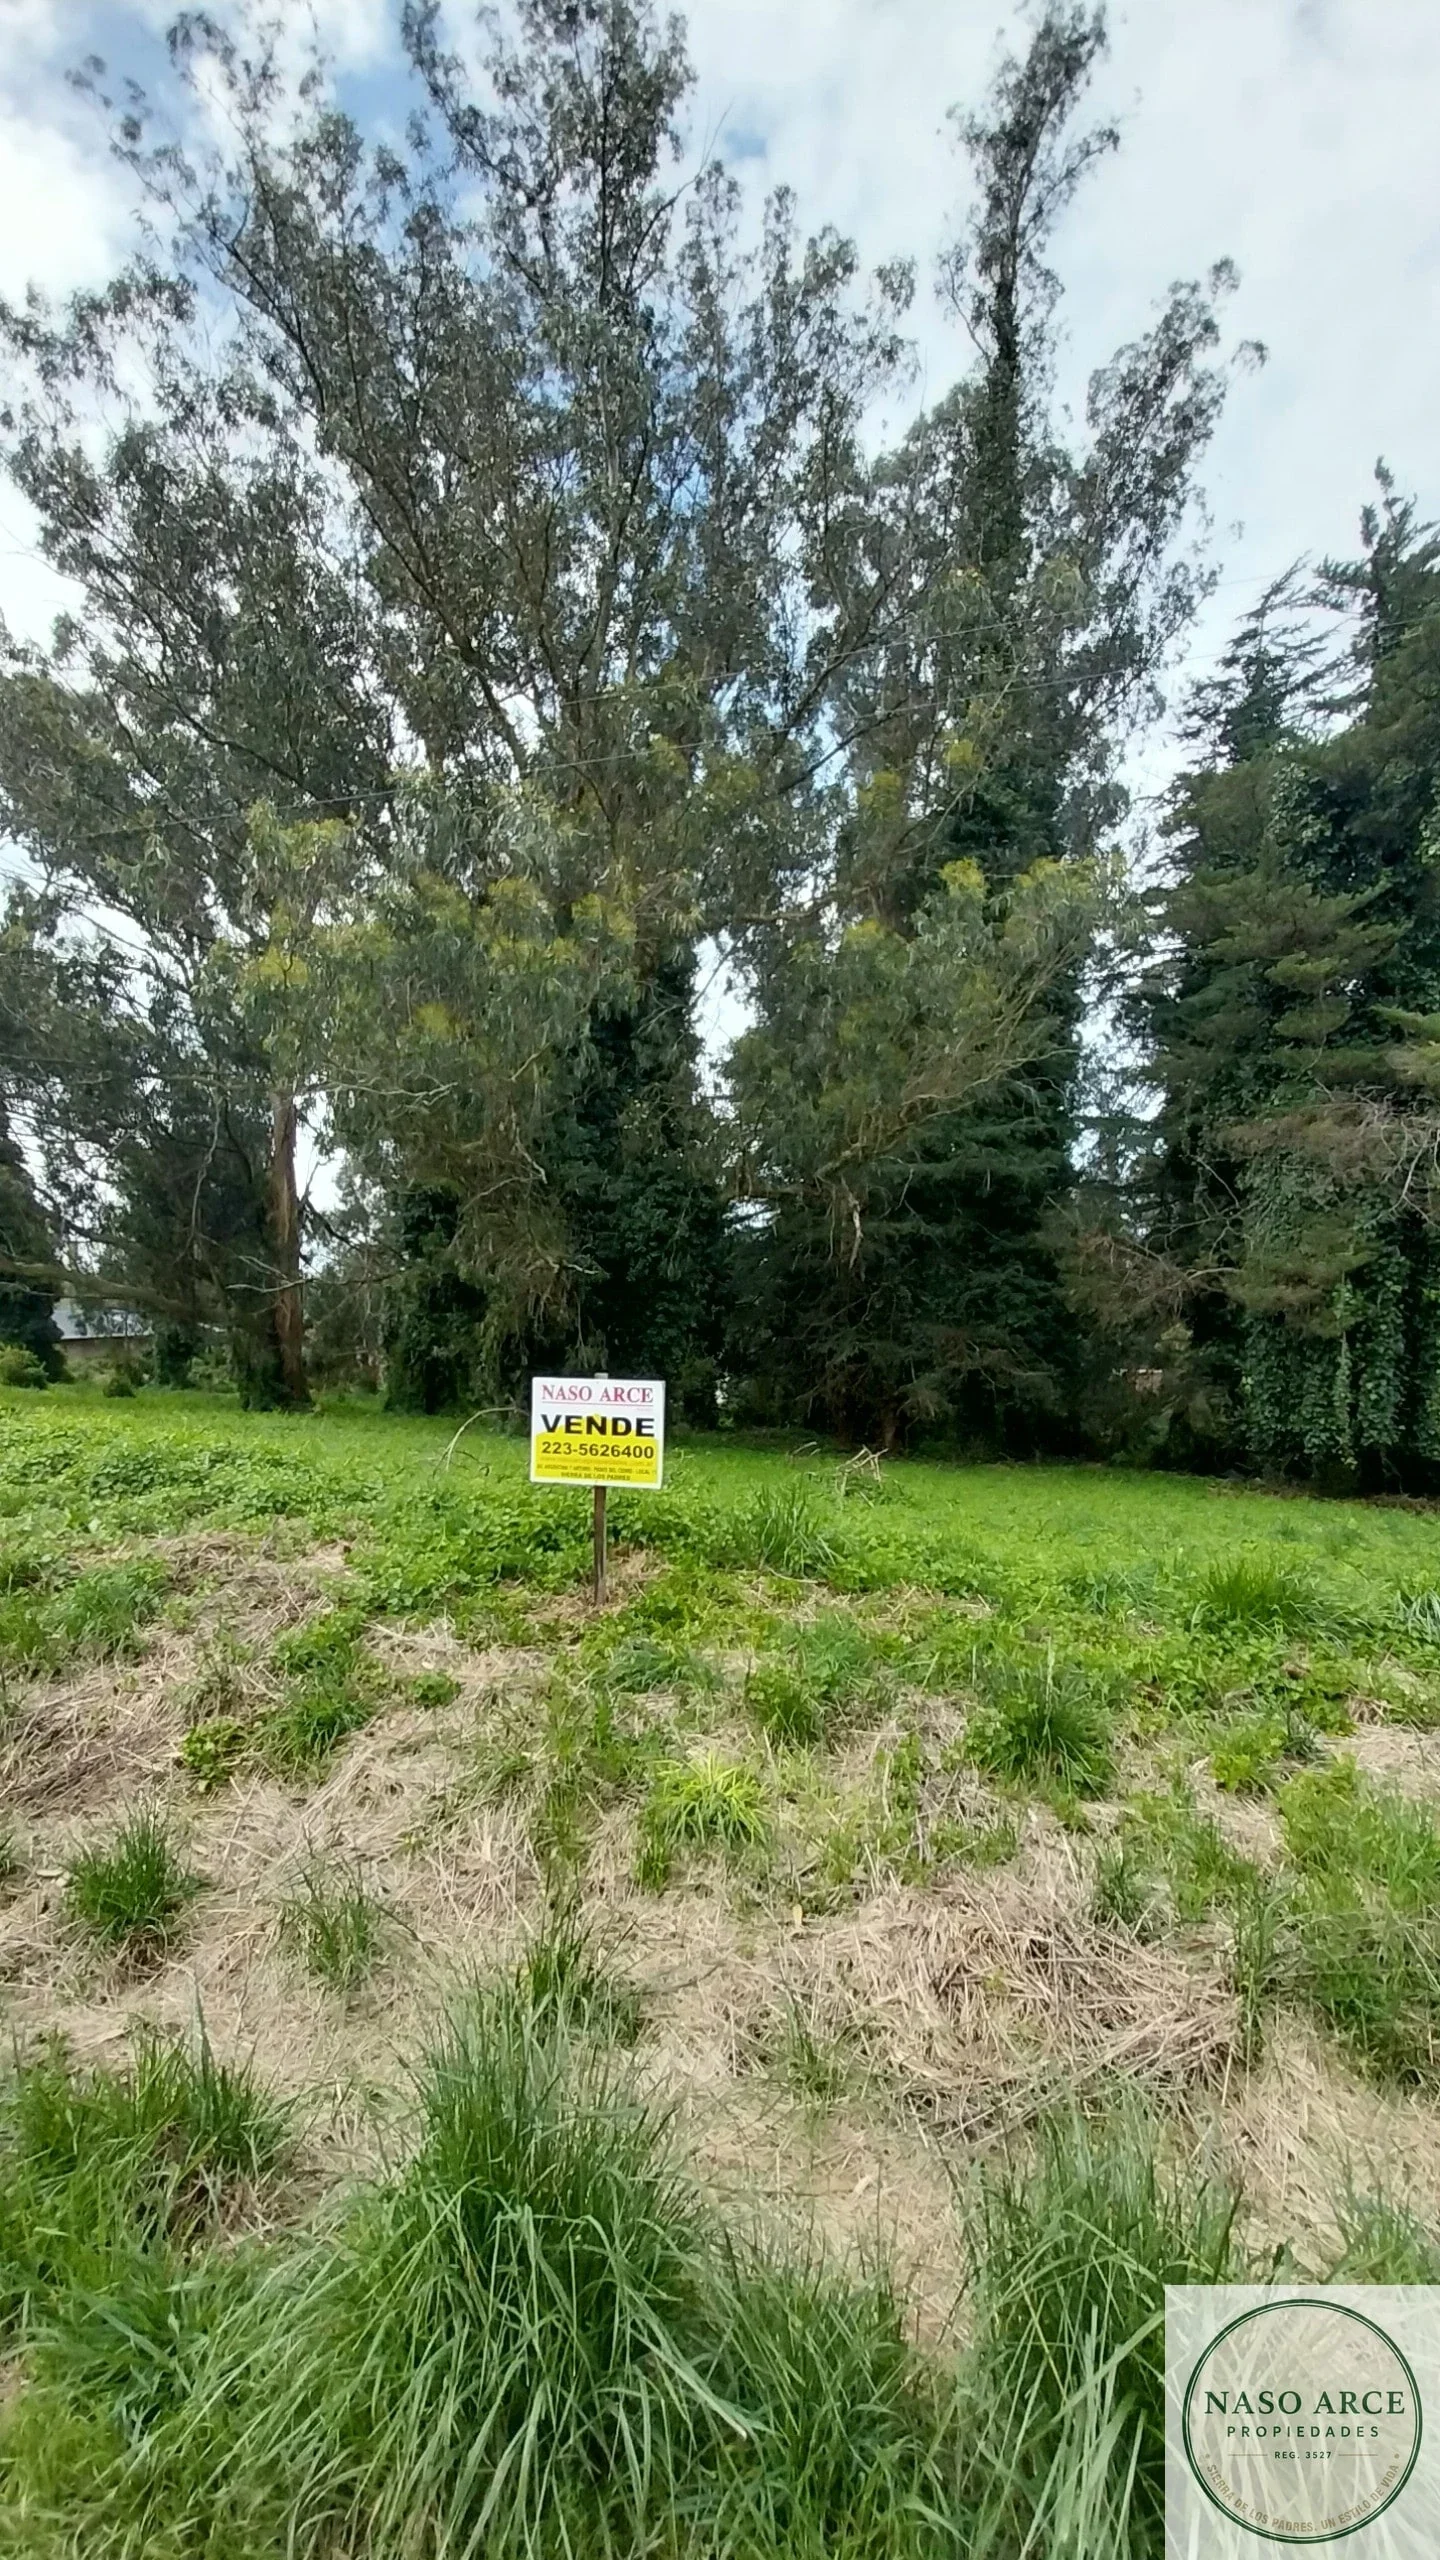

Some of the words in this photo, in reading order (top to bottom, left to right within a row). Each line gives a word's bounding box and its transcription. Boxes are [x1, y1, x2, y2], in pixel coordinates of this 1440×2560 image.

[542, 1385, 592, 1401] NASO
[600, 1387, 653, 1403] ARCE
[541, 1414, 655, 1437] VENDE
[541, 1441, 654, 1459] 223-5626400
